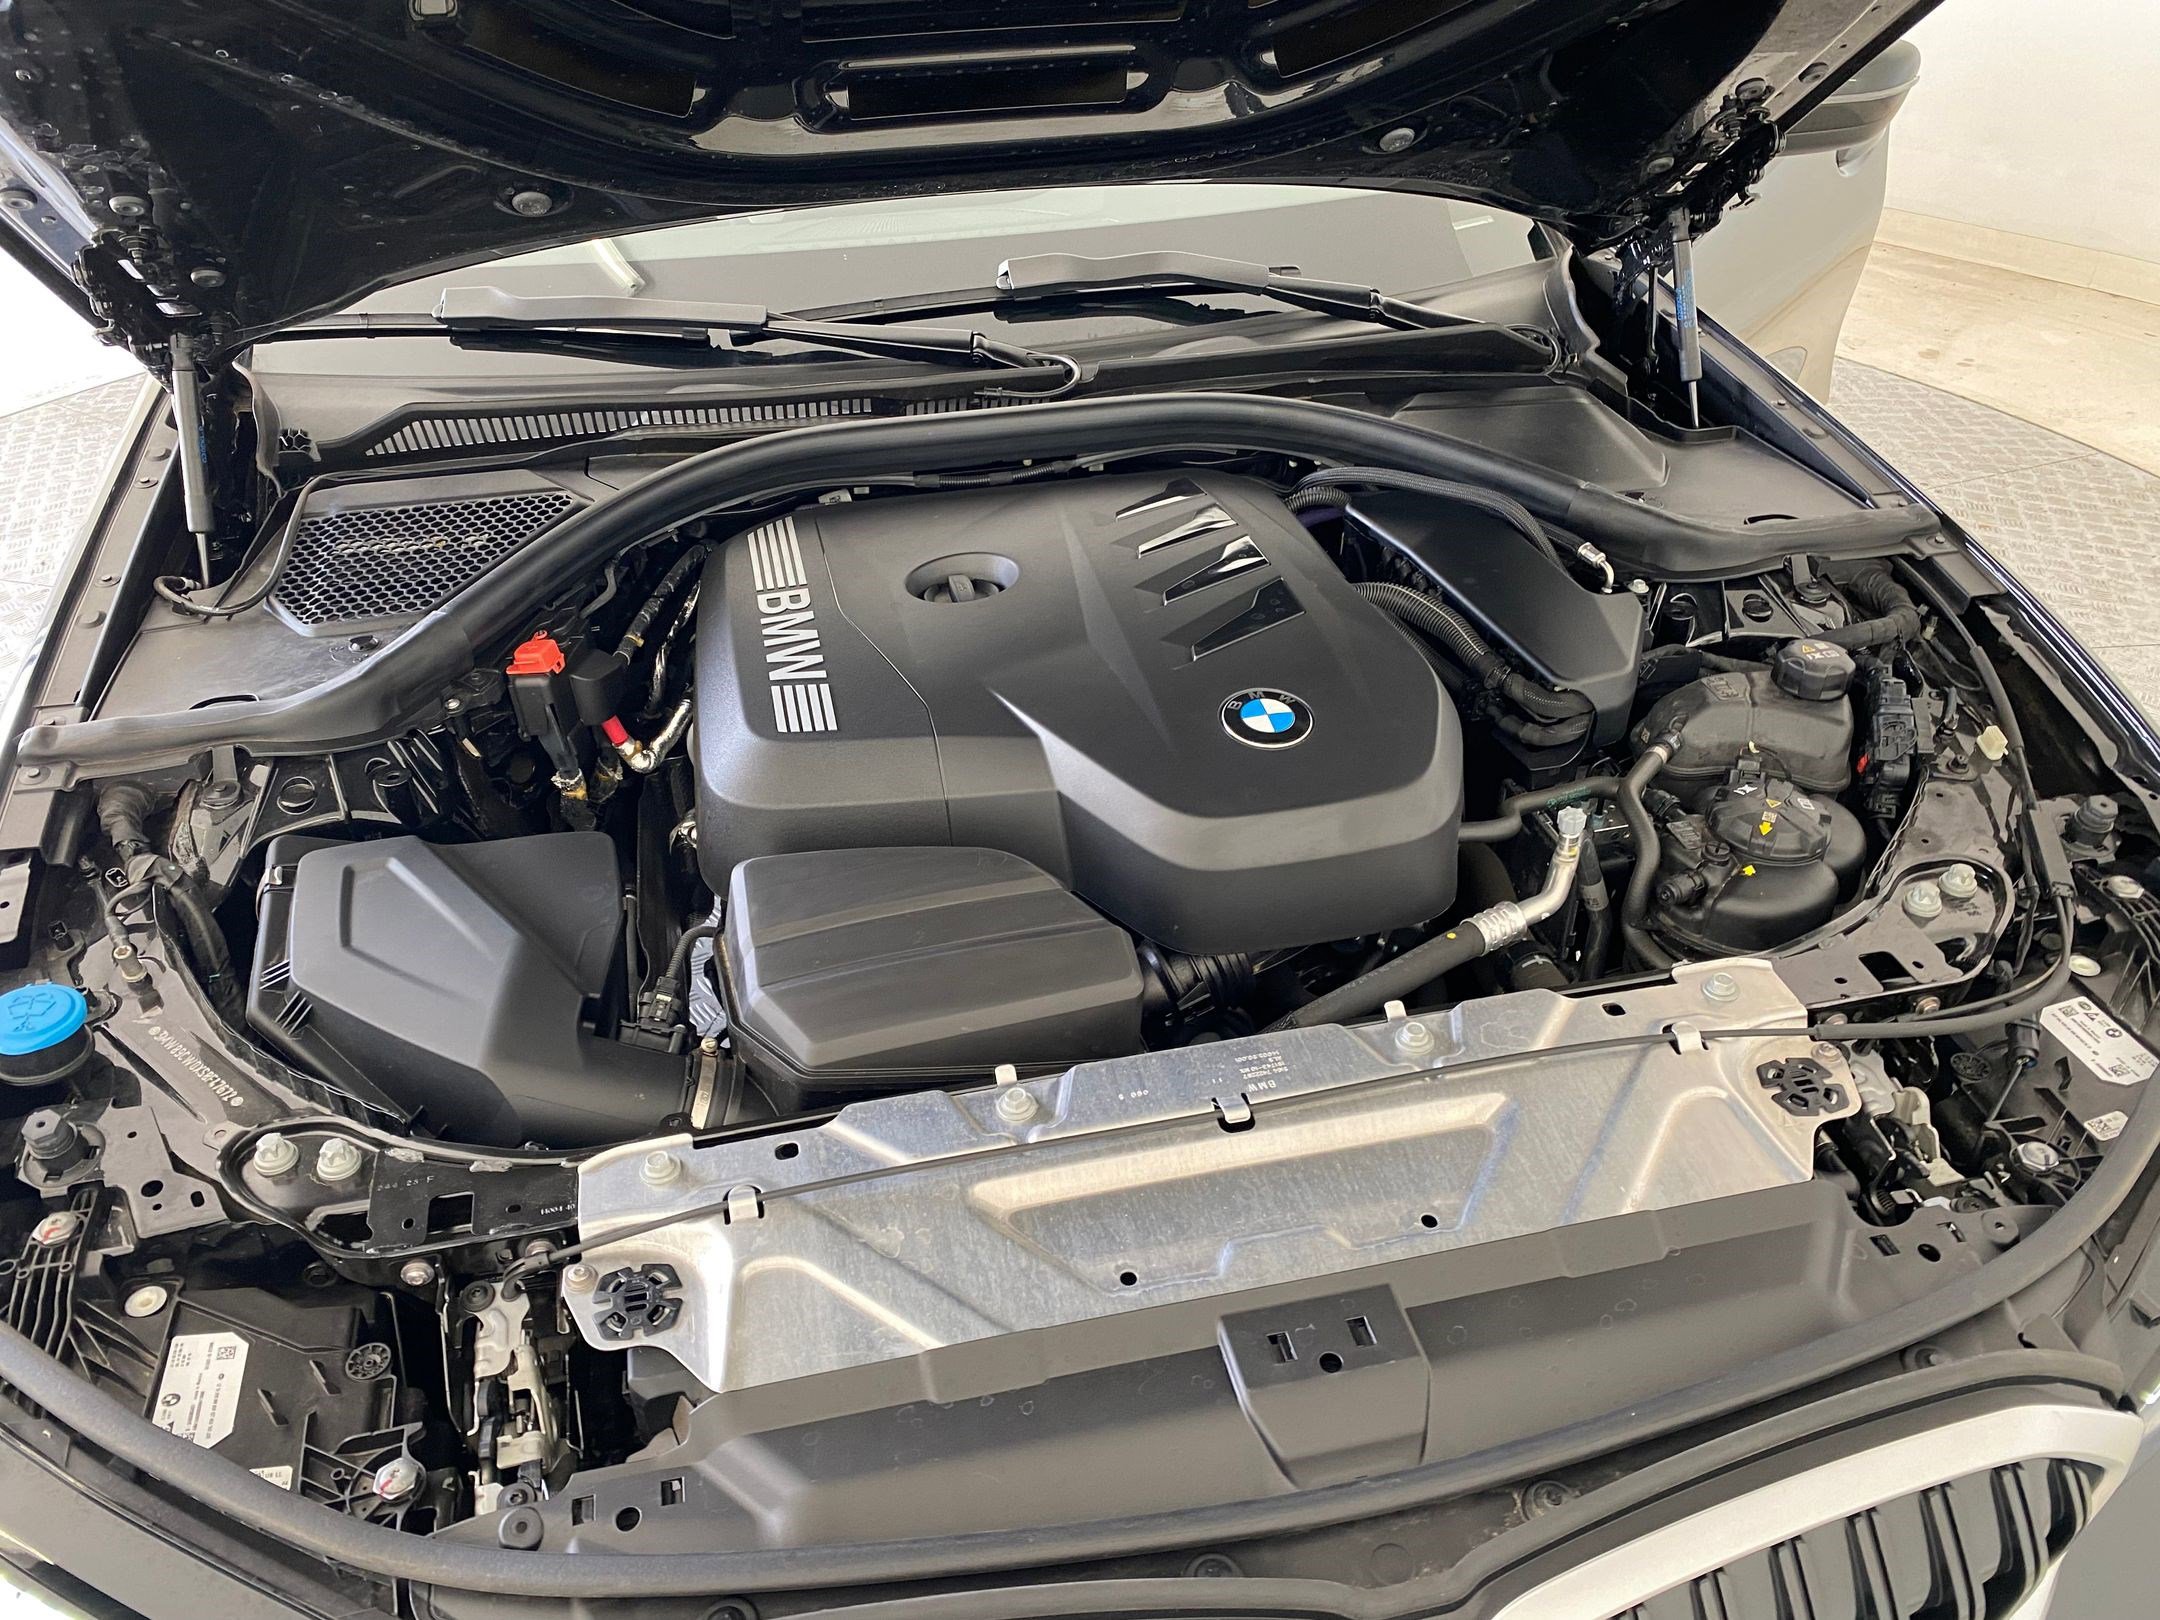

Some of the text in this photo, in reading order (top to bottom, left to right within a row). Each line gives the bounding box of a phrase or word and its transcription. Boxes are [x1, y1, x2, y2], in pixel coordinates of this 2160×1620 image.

[757, 588, 827, 680] BMW
[1227, 691, 1296, 711] BMW
[1248, 1079, 1277, 1092] BMW
